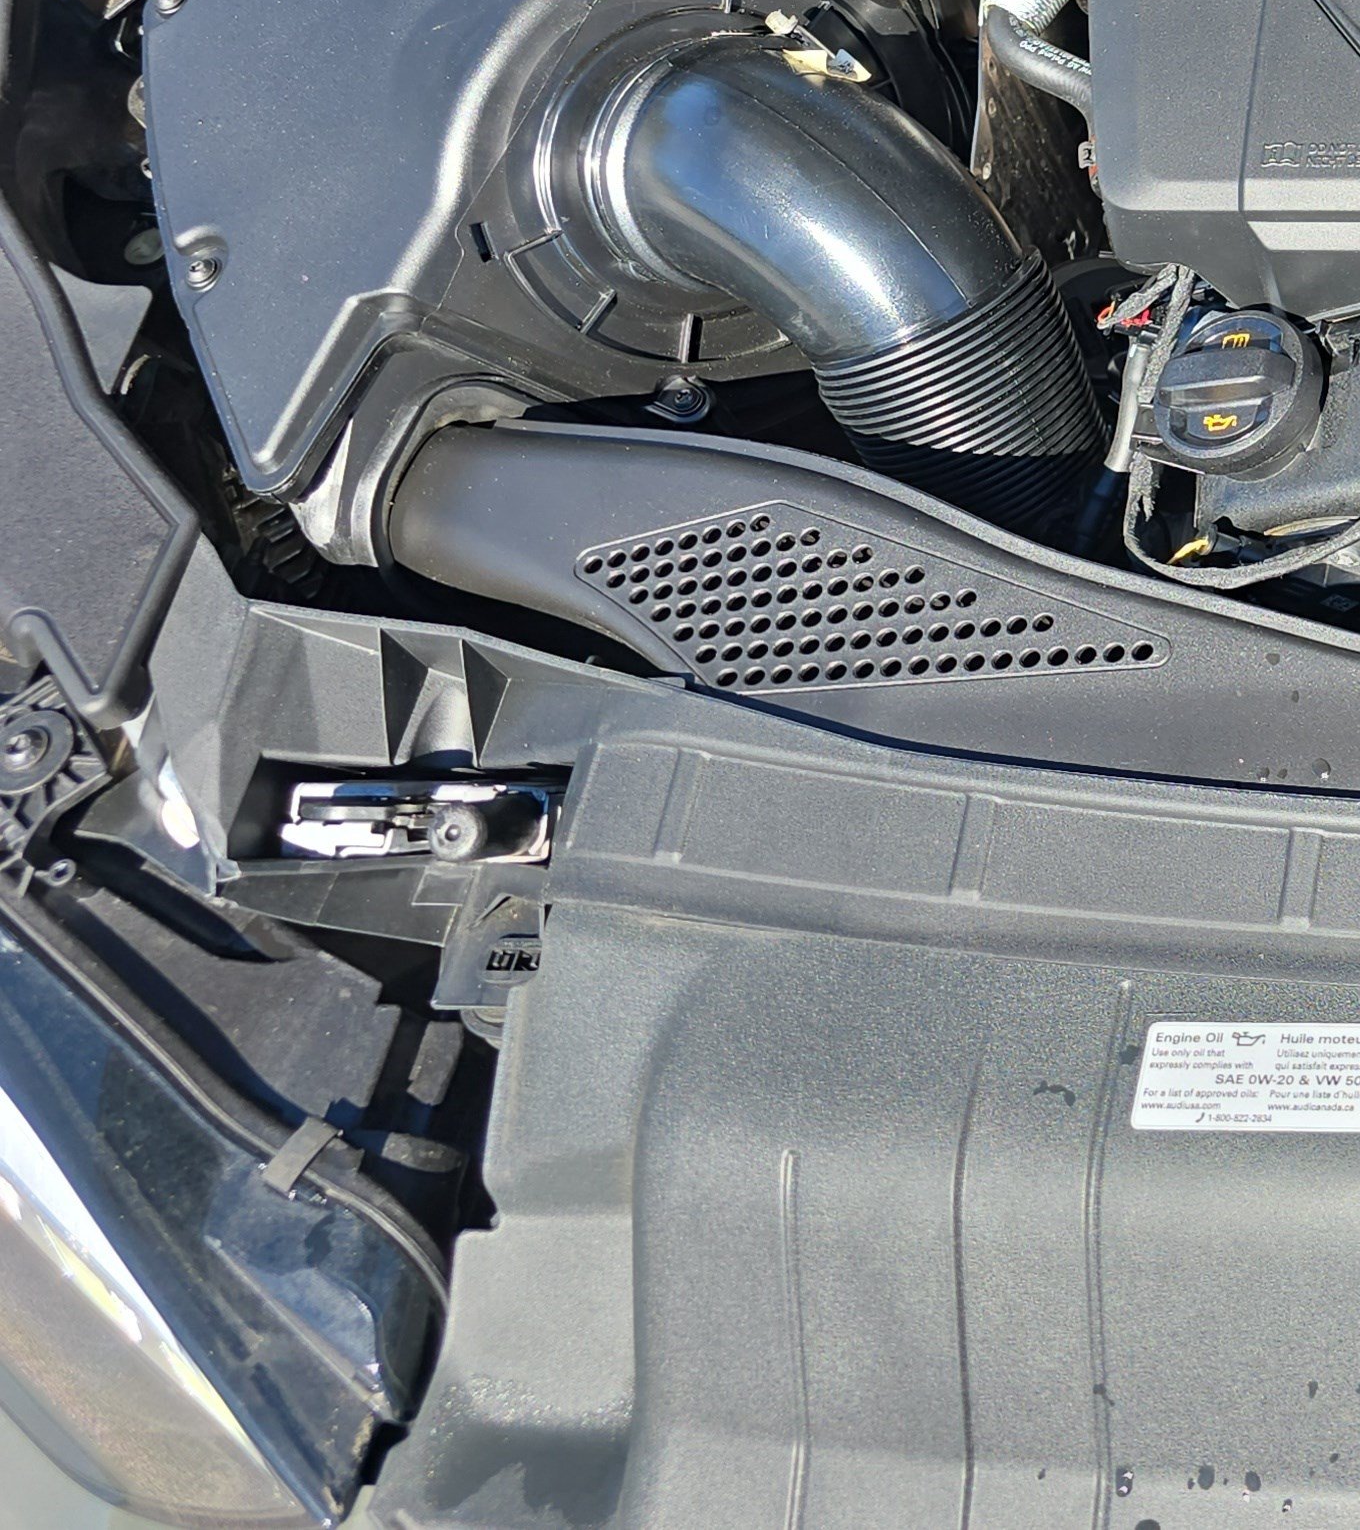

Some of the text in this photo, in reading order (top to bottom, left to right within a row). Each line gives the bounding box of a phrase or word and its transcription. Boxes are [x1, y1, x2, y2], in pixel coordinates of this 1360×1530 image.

[1155, 1032, 1225, 1045] Engine Oil
[1280, 1033, 1314, 1045] Huile
[1151, 1048, 1225, 1058] Use only oil that
[1276, 1048, 1309, 1059] Utilisez
[1149, 1060, 1254, 1070] expressly complies with
[1274, 1062, 1291, 1072] qui
[1291, 1062, 1327, 1071] satisfait
[1214, 1074, 1245, 1085] SAE
[1248, 1074, 1295, 1085] 0W-20
[1298, 1074, 1310, 1086] &
[1315, 1075, 1342, 1086] VW
[1143, 1088, 1159, 1097] For
[1168, 1088, 1182, 1097] list
[1184, 1088, 1194, 1097] of
[1195, 1089, 1238, 1099] approved
[1269, 1089, 1291, 1099] Pour
[1292, 1091, 1310, 1099] une
[1312, 1090, 1331, 1100] liste
